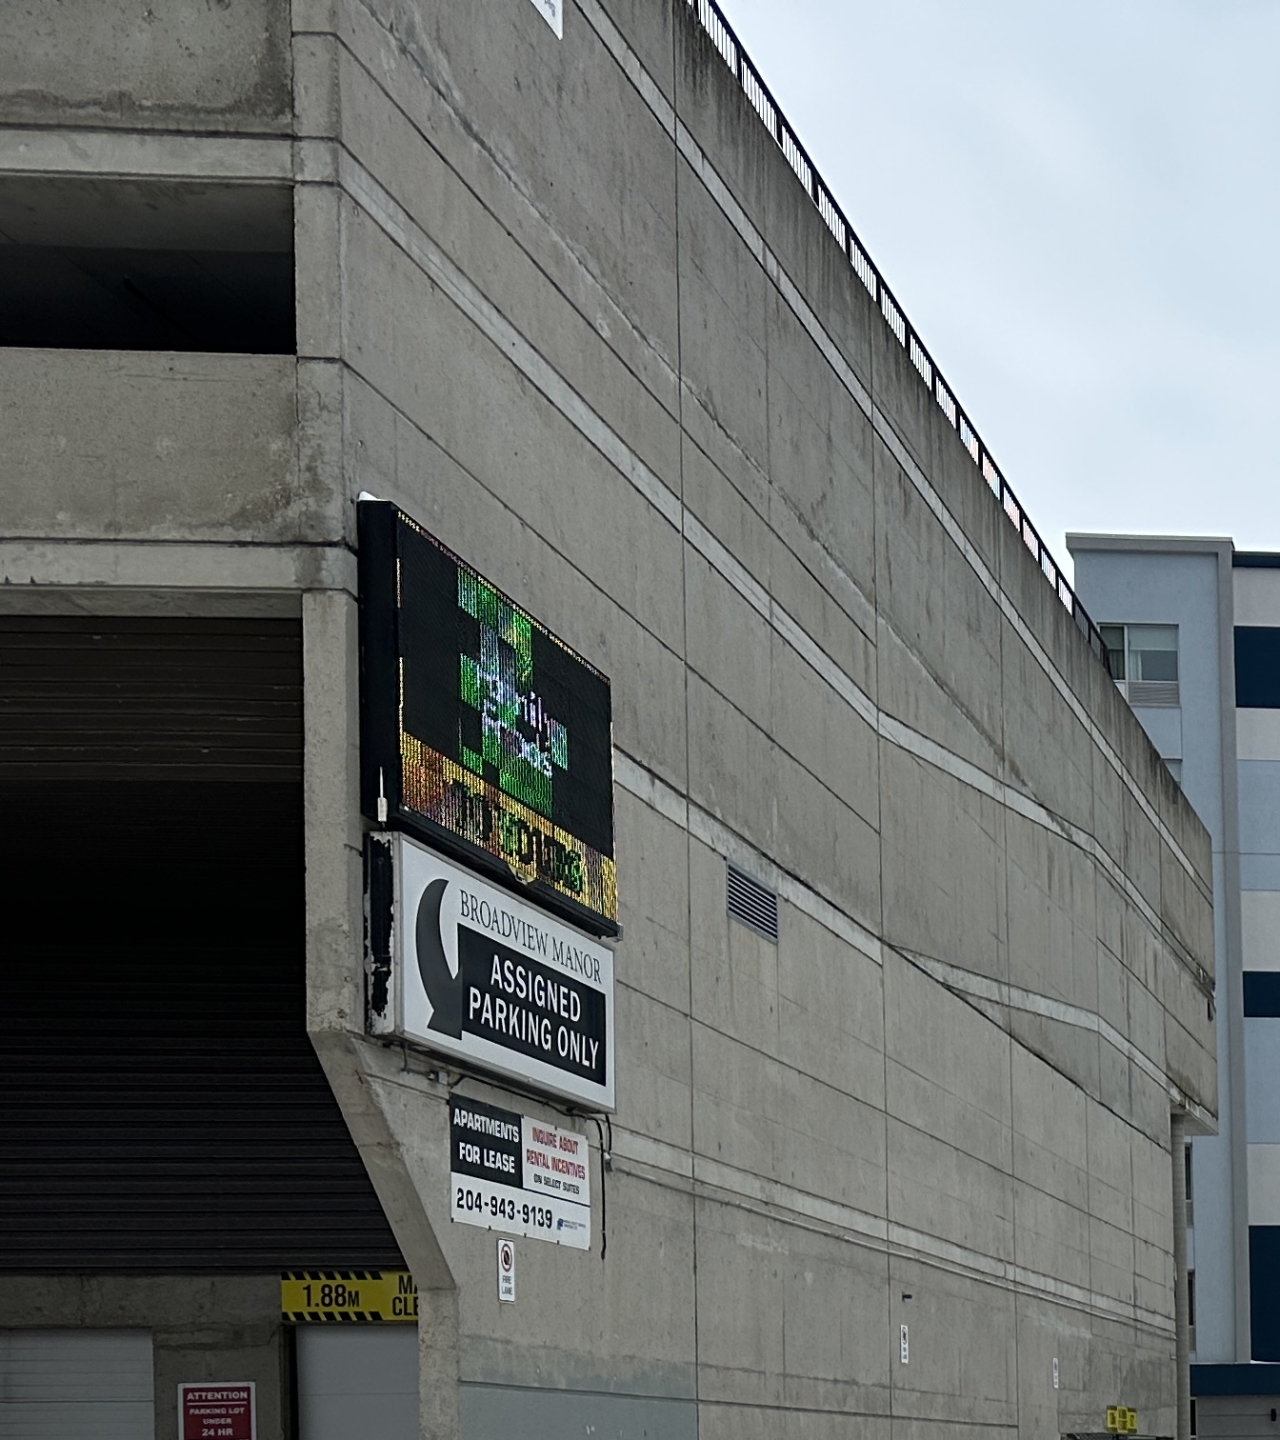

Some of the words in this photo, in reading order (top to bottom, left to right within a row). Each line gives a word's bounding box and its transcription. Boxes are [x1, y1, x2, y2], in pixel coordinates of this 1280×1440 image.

[460, 889, 548, 951] BROADVIEW
[552, 936, 602, 984] MANOR
[490, 954, 581, 1022] ASSIGNED
[469, 986, 551, 1050] PARKING
[558, 1025, 599, 1069] ONLY
[453, 1108, 519, 1143] APARTMENTS
[459, 1142, 480, 1165] FOR
[483, 1150, 515, 1174] LEASE
[559, 1136, 578, 1155] ABOUT
[526, 1148, 550, 1170] RENTAL
[551, 1156, 585, 1180] INCENTIVES
[456, 1187, 553, 1229] 204-943-9139
[186, 1391, 248, 1400] ATTENTION
[202, 1428, 215, 1436] 24
[218, 1428, 233, 1436] HR
